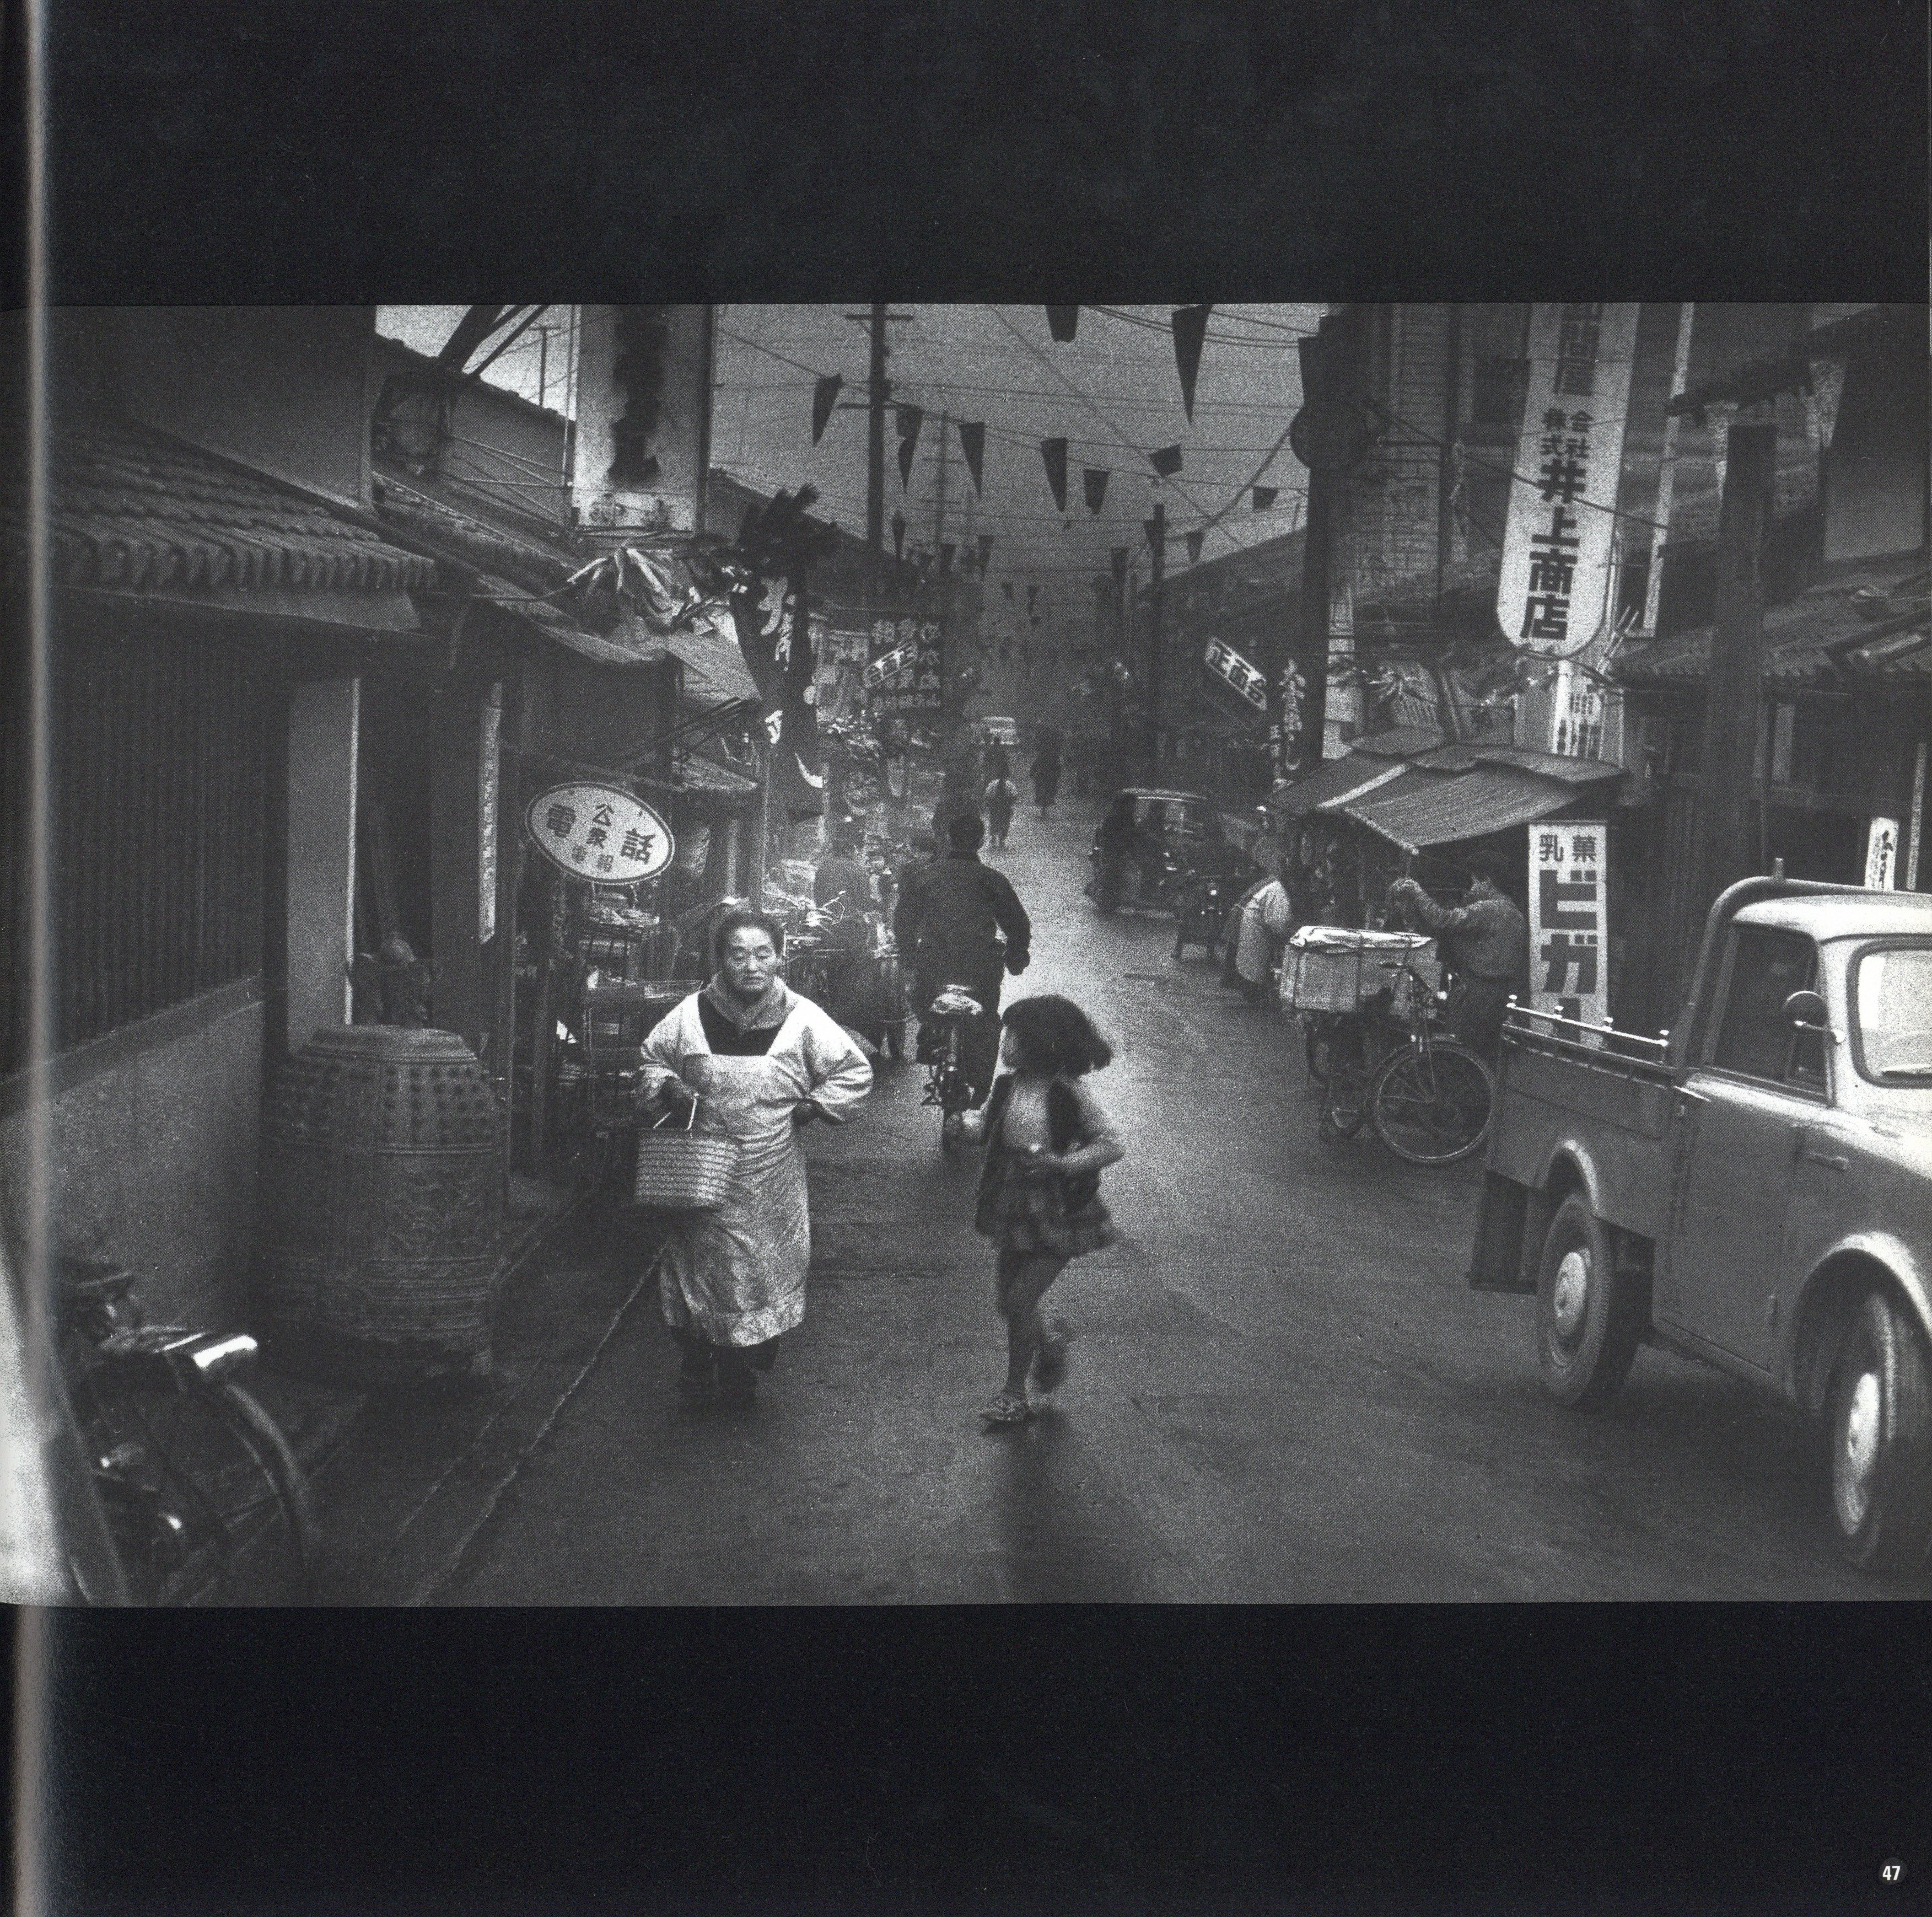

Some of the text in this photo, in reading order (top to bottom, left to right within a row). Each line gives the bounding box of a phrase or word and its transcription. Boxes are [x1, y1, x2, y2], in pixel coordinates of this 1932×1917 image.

[1520, 458, 1587, 641] 井上商店
[585, 803, 615, 849] 公衆
